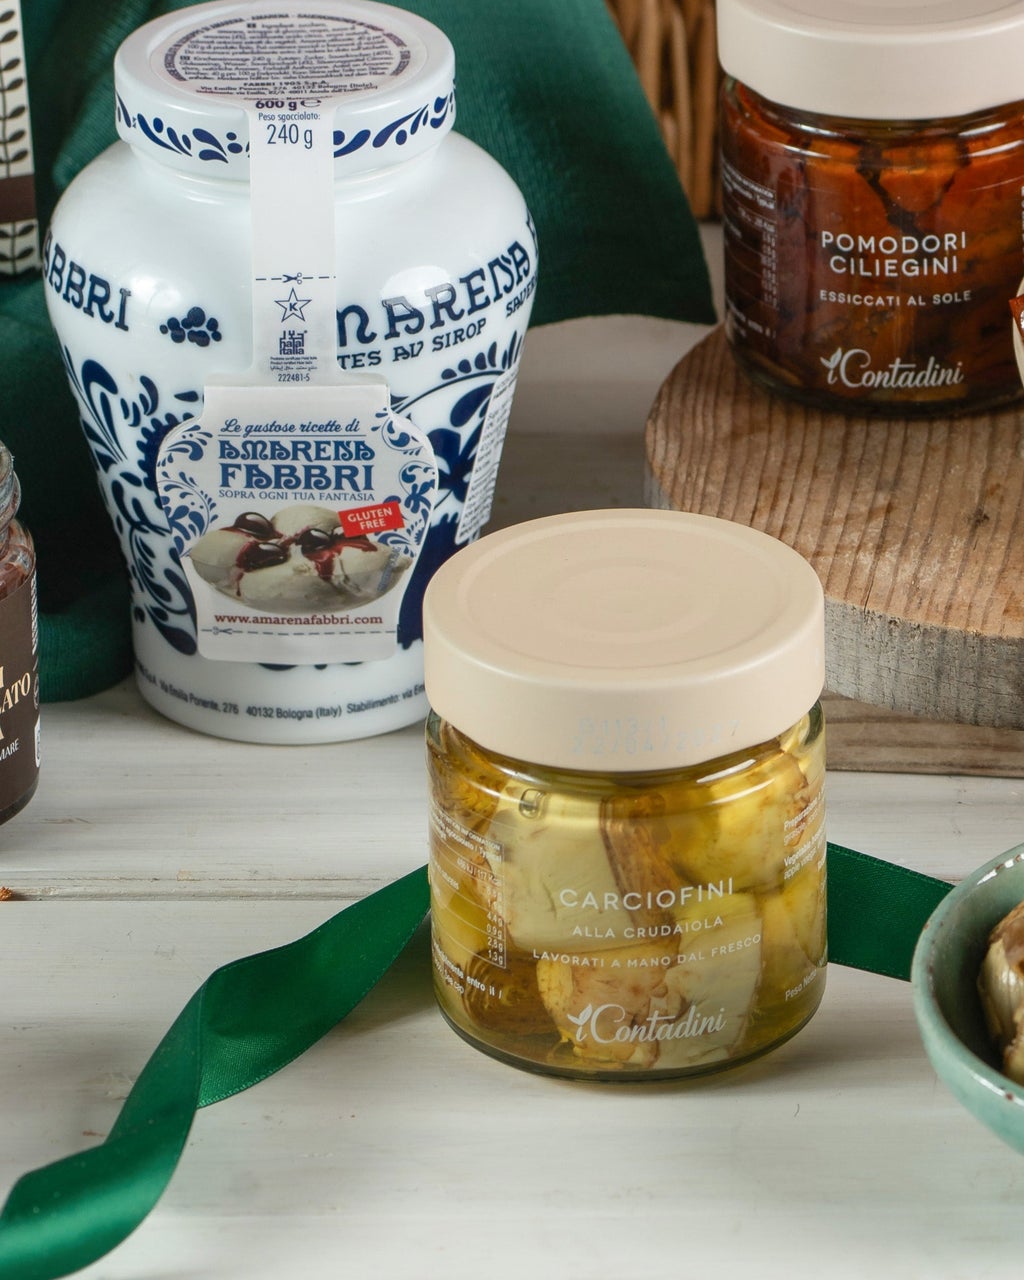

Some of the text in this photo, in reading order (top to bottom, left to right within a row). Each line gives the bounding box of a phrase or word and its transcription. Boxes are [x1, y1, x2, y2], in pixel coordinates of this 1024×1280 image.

[255, 100, 284, 109] 600
[258, 111, 321, 122] Peso sgocciolato:
[266, 123, 313, 150] 240 g
[821, 230, 967, 253] POMODORI
[829, 255, 959, 277] CILIEGINI
[819, 289, 972, 307] ESSICCATI AL SOLE
[431, 317, 488, 353] SIROP
[278, 373, 310, 382] 222481-5
[221, 418, 359, 437] Le gustose ricette di
[218, 440, 375, 462] AMARENA
[218, 463, 374, 491] FABBRI
[219, 489, 375, 501] SOPRA OGNI TUA FANTASIA
[347, 506, 393, 524] GLUTEN
[359, 518, 386, 530] FREE
[214, 613, 383, 625] www.amarenafabbri.com
[246, 705, 274, 718] 40132
[276, 707, 314, 721] Bologna
[315, 705, 342, 719] (Italy)
[559, 877, 735, 912] CARCIOFINI
[572, 915, 724, 939] ALLA CRUDAIOLA
[532, 934, 762, 969] LAVORATI A MANO DAL FRESCO
[466, 975, 486, 992] entro
